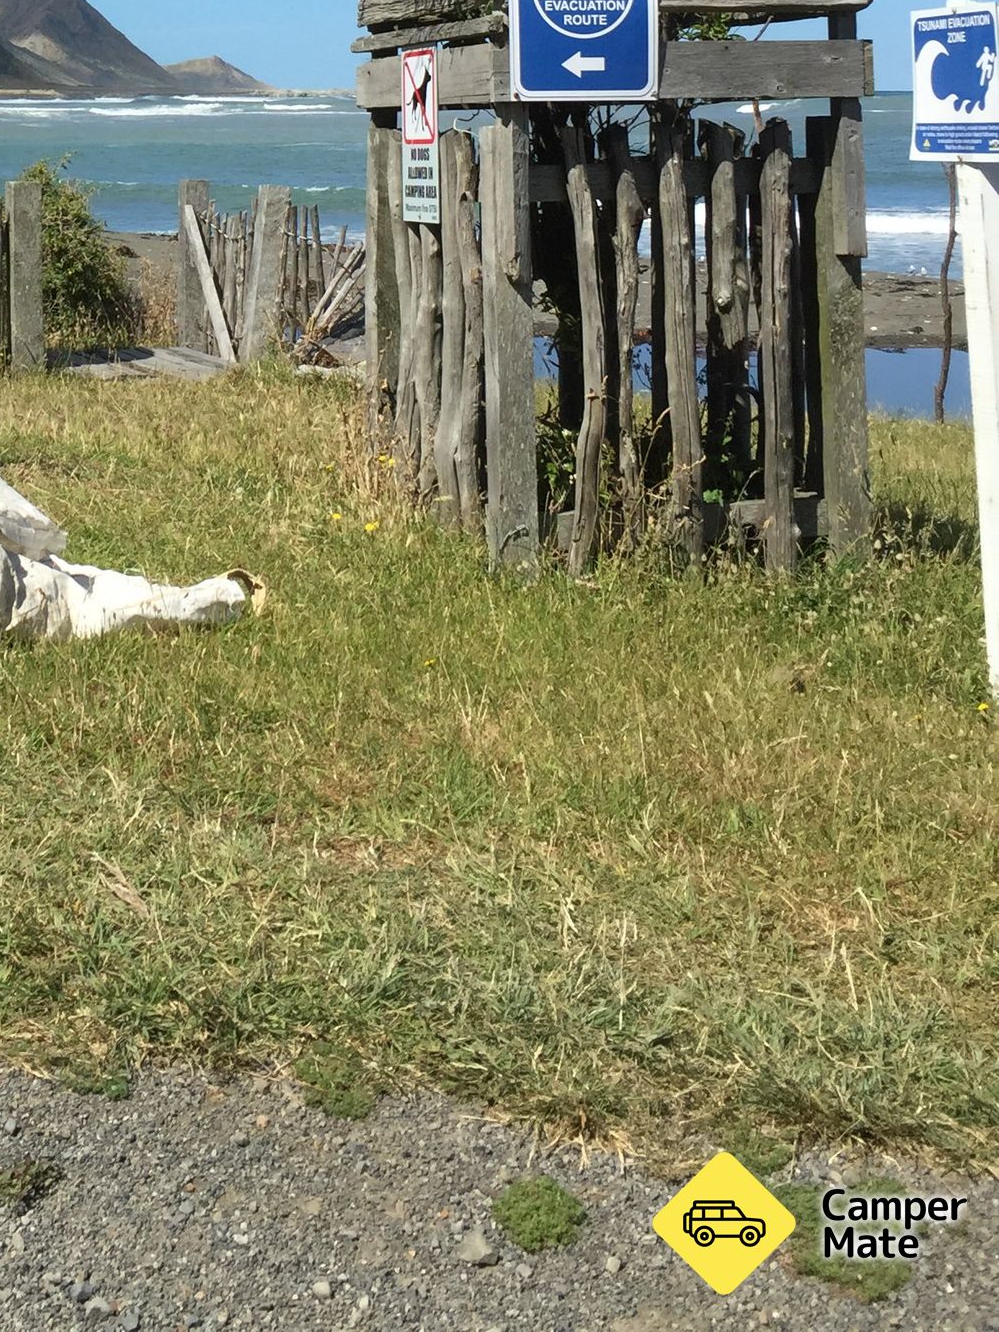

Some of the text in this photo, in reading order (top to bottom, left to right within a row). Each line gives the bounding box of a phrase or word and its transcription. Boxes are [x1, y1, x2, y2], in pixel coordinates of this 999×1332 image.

[544, 0, 626, 11] EVACUATION
[563, 14, 608, 26] ROUTE
[917, 14, 990, 31] TSUNAMI EVACUATION
[947, 31, 967, 43] ZONE
[411, 148, 430, 161] NO DOGS
[408, 167, 427, 179] ALLOWED
[405, 185, 437, 199] CAMPING AREA
